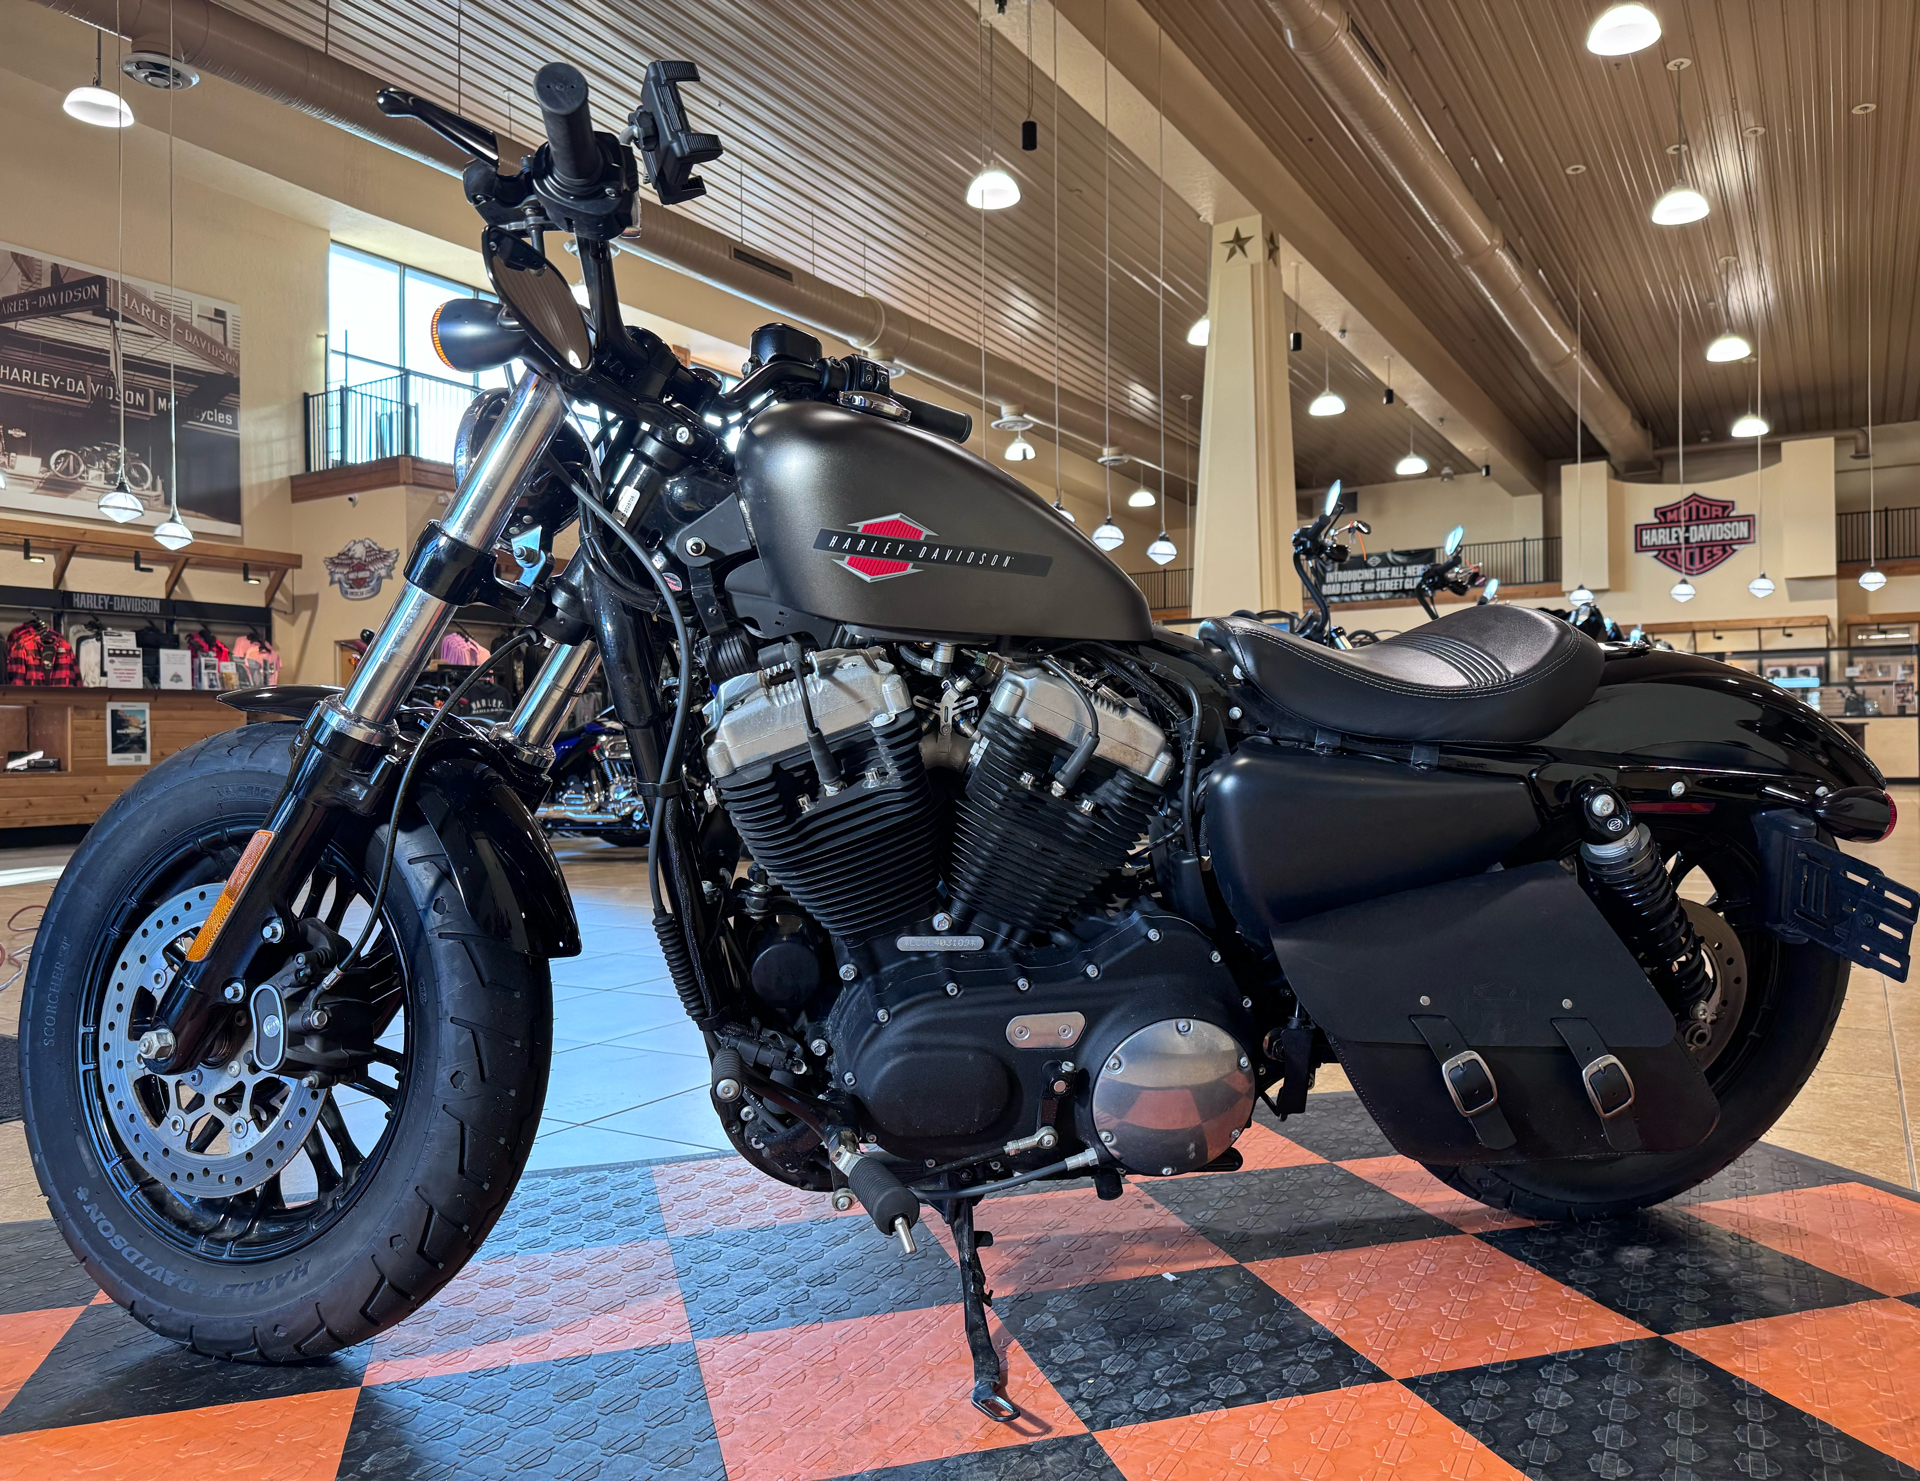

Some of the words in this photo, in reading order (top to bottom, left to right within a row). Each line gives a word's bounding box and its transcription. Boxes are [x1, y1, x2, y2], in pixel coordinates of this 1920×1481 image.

[121, 290, 239, 368] HARLEY-DAVIDSON
[1666, 502, 1723, 523] MOTOR
[1642, 521, 1749, 547] HARLEY-DAVIDSON
[828, 535, 1012, 568] HARLEY-DAVIDSON
[1666, 546, 1723, 570] CYCLES
[1326, 568, 1376, 583] INTRODUCING
[1376, 566, 1391, 579] THE
[1322, 583, 1341, 595] ROAD
[1341, 582, 1363, 594] GLIDE
[1376, 579, 1404, 592] STREET
[73, 593, 160, 614] HARLEY-DAVIDSON
[43, 961, 67, 1047] SCORCHER
